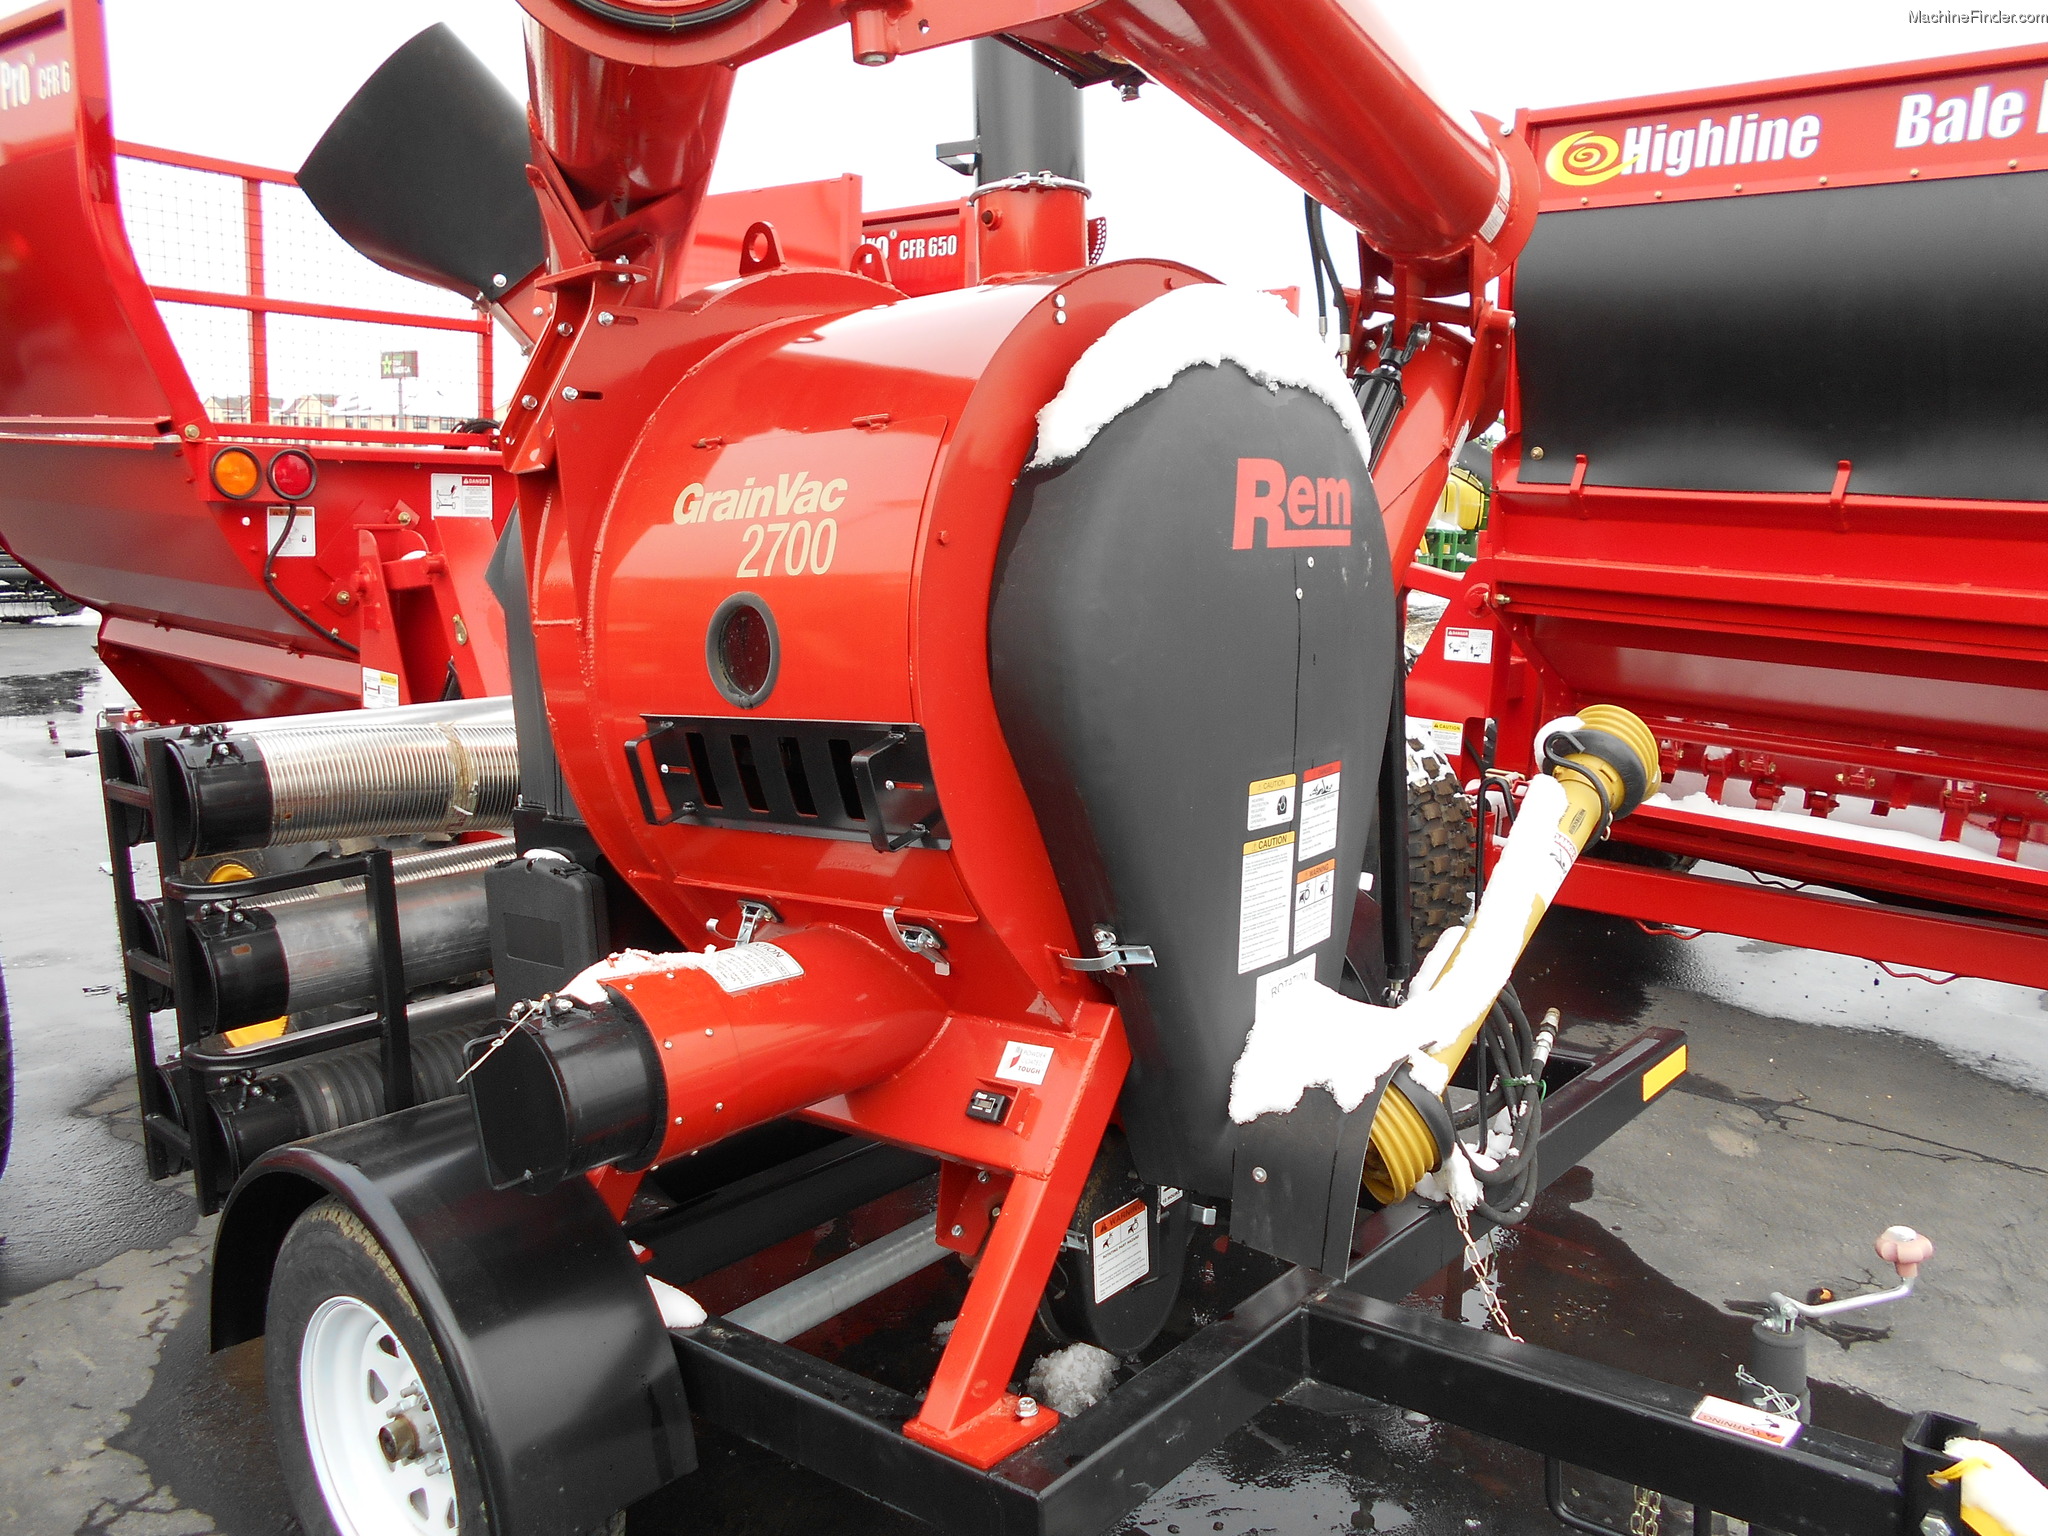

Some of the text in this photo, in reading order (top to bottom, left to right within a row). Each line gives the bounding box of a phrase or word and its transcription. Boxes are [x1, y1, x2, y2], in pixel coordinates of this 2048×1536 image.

[39, 64, 61, 99] CFR
[1894, 84, 2026, 149] Bale
[1620, 112, 1822, 178] Highline
[900, 239, 925, 261] CFR
[928, 234, 958, 258] 650
[672, 471, 849, 526] GrainVac
[1232, 457, 1352, 550] Rem
[736, 518, 838, 578] 2700
[1438, 723, 1461, 731] CAUTION
[1263, 778, 1286, 790] CAUTION
[1258, 834, 1288, 850] CAUTION
[1018, 1065, 1041, 1074] TOUGH
[1109, 1202, 1143, 1226] WARNING
[1703, 1415, 1762, 1435] WARNING
